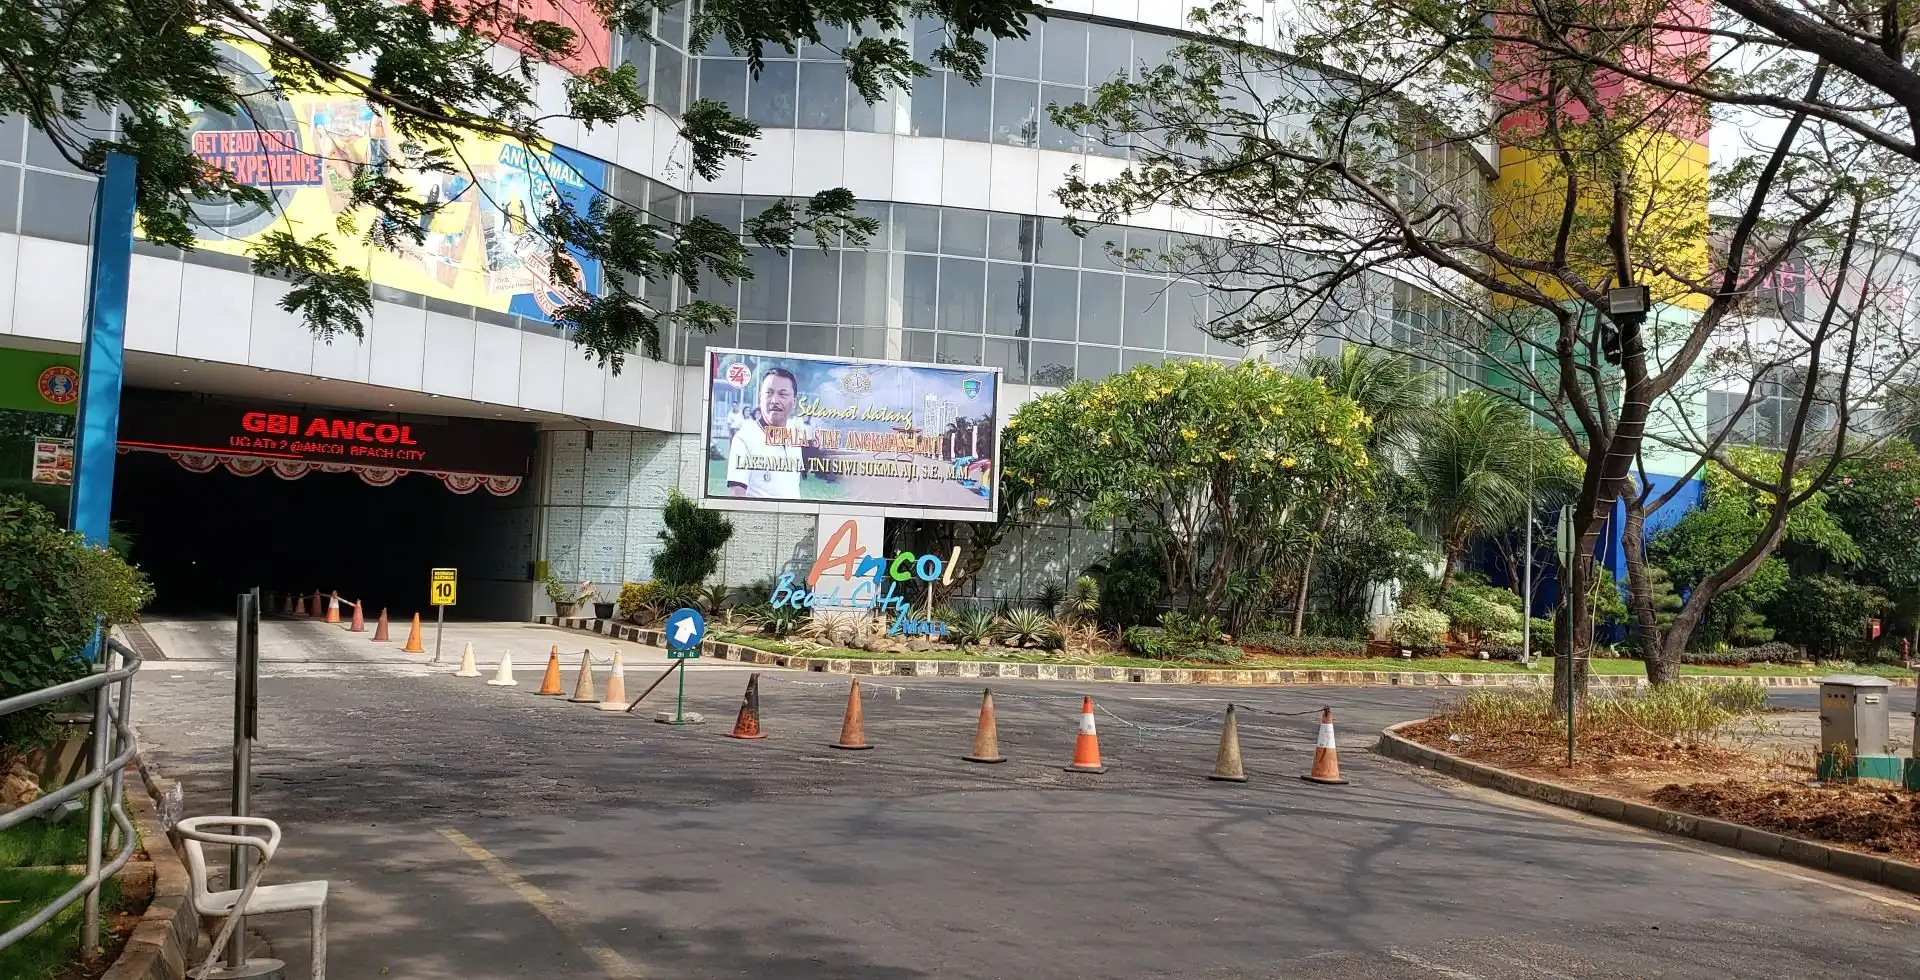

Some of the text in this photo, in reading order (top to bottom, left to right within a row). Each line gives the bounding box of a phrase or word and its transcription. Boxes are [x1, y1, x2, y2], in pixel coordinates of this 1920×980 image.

[195, 132, 294, 153] GET READY FOR A
[229, 154, 321, 184] EXPERIENCE
[500, 144, 585, 190] ANCOL MALL
[798, 396, 913, 431] Selamat datang
[242, 412, 417, 445] GBI ANCOL
[764, 425, 809, 447] KEPALA
[813, 428, 842, 449] STAF
[397, 449, 426, 461] CITY
[736, 455, 806, 472] LAKSAMANA
[808, 457, 830, 473] TNI
[832, 459, 858, 476] SIWI
[860, 460, 899, 477] SUKMA
[900, 463, 920, 482] AJI,
[807, 519, 962, 586] Ancol
[436, 583, 452, 597] 10
[769, 571, 910, 636] Beach City
[902, 619, 951, 636] MALL
